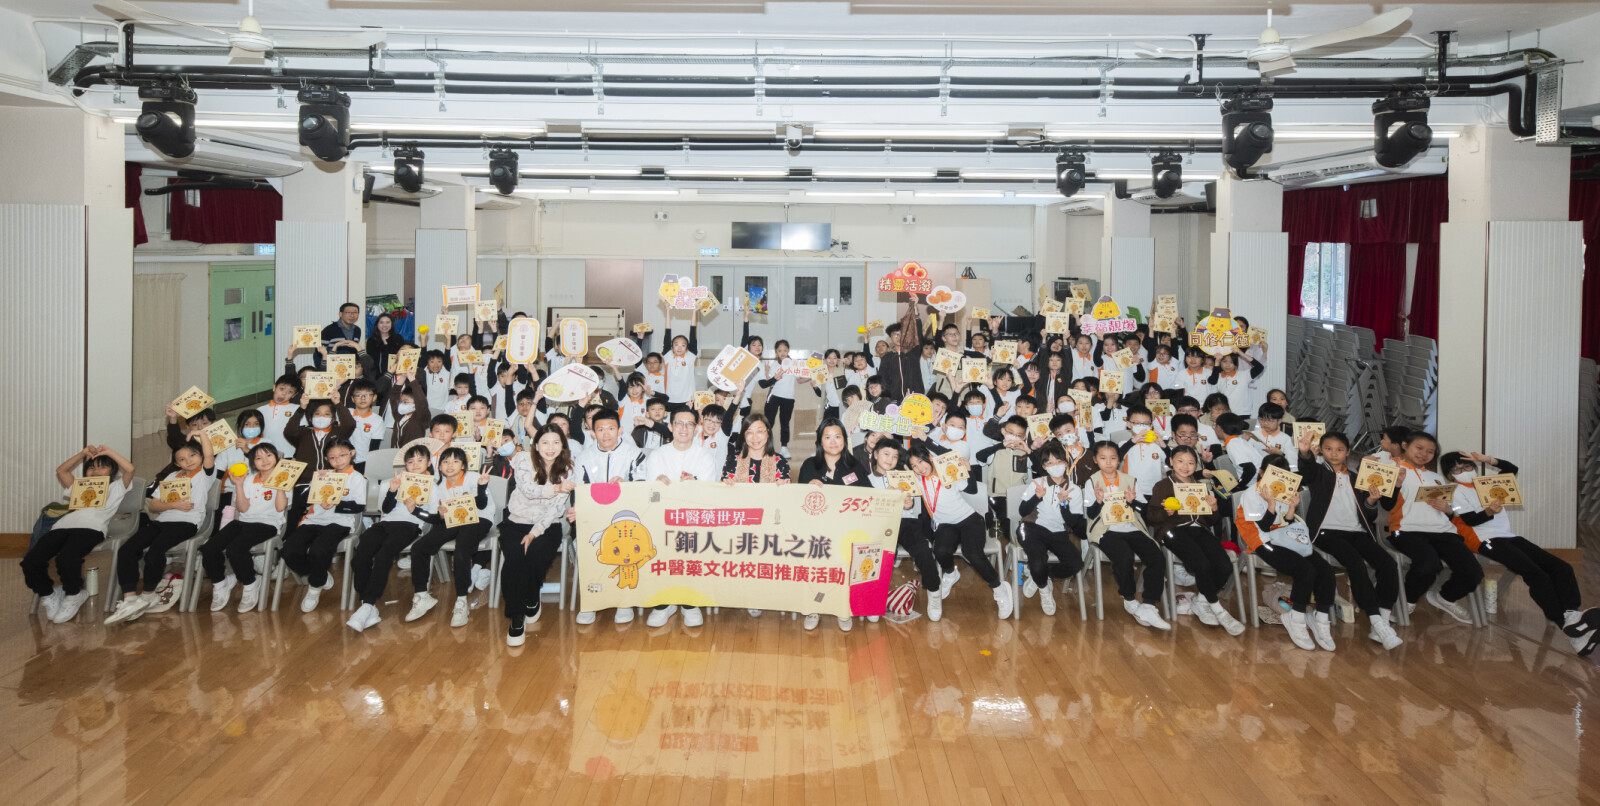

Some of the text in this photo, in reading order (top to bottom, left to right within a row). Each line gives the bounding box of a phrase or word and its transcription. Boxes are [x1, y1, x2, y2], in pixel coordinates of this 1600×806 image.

[880, 278, 931, 292] 精靈活潑
[1081, 318, 1136, 334] 幸福靚爆
[1189, 332, 1249, 347] 同修仁德
[665, 530, 832, 560] 「銅人」非凡之旅
[650, 559, 846, 586] 中醫藥文化校園推廣活動
